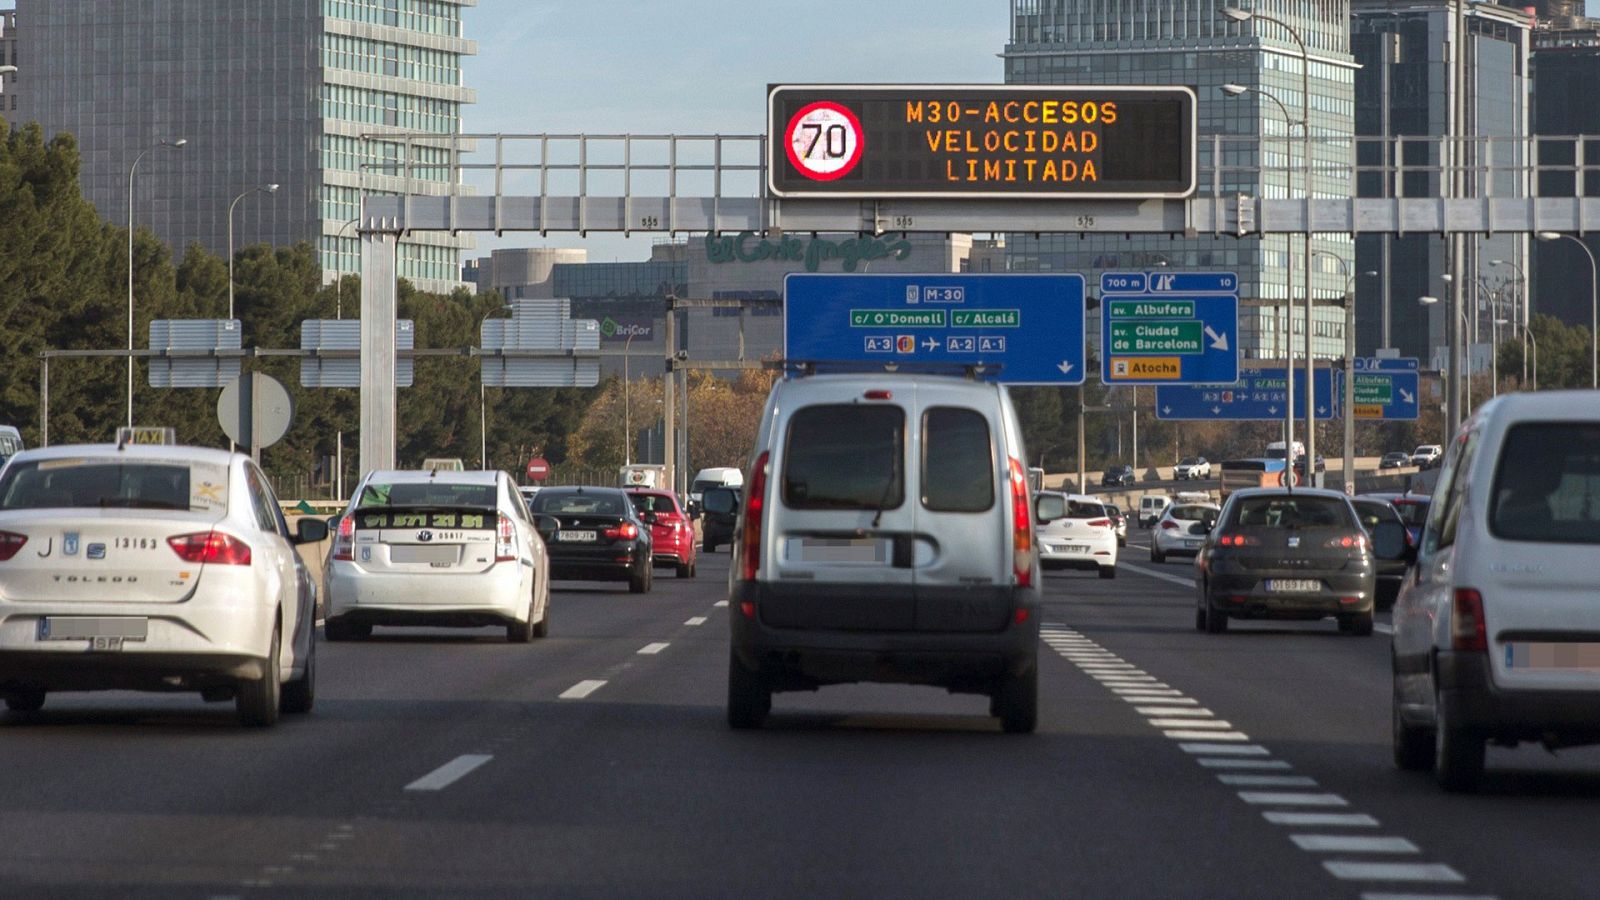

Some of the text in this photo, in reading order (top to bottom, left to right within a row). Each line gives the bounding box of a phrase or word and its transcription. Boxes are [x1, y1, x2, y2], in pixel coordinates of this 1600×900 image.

[906, 101, 1117, 124] M30-ACCESOS
[802, 124, 846, 158] 70
[926, 130, 1098, 152] VELOCIDAD
[946, 159, 1098, 182] LIMITADA
[1107, 278, 1140, 288] 700 m
[1220, 279, 1231, 287] 10
[927, 289, 962, 301] M-30
[1113, 304, 1191, 315] av. Albufera
[855, 313, 942, 324] c/ O'Donnell
[955, 311, 1015, 324] c/ Alcalá
[616, 324, 651, 336] BriCor
[1113, 325, 1178, 337] av. Ciudad
[867, 339, 891, 350] A-3
[950, 339, 973, 350] A-2
[981, 339, 1004, 350] A-1
[1114, 339, 1197, 350] de Barcelona
[1132, 362, 1176, 373] Atocha
[134, 431, 163, 444] TAXI
[53, 575, 137, 583] TOLEDO
